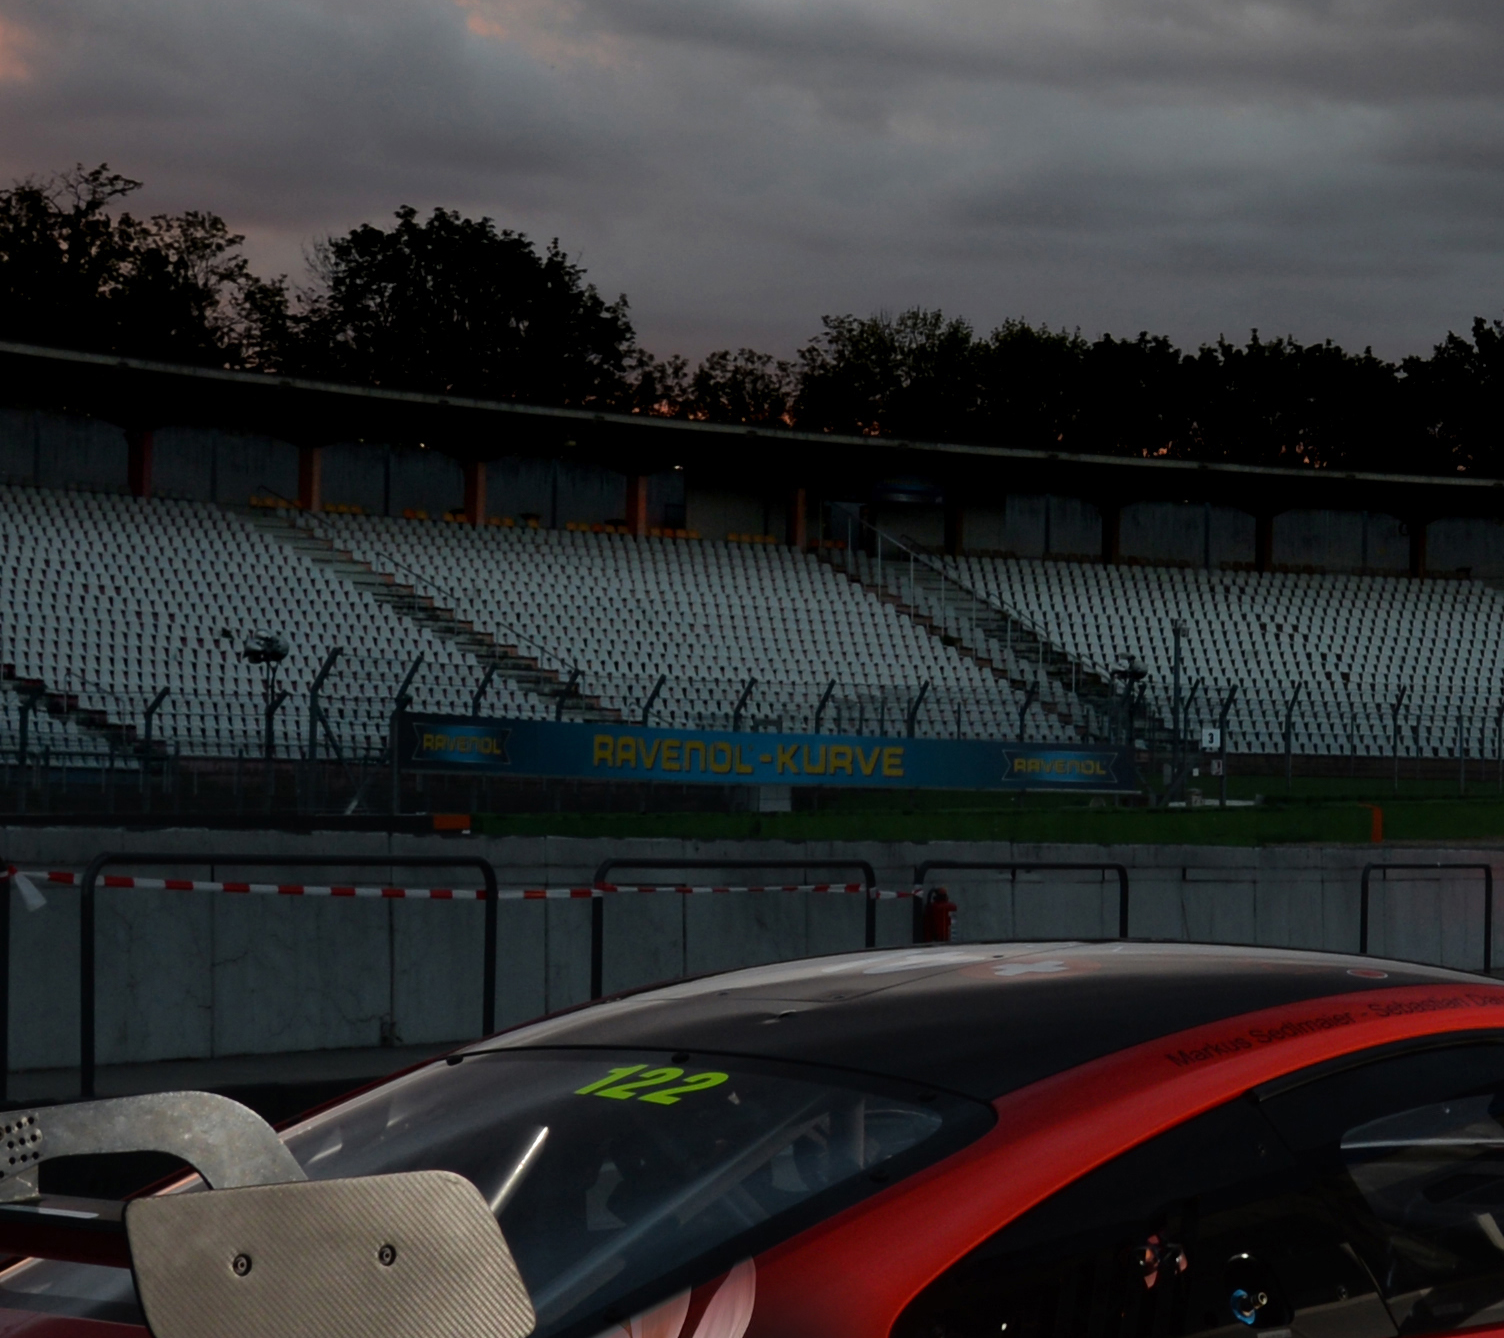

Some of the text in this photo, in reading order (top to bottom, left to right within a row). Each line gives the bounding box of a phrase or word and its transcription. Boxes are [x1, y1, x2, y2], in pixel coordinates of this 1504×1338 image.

[422, 733, 502, 755] RAVENOL
[1013, 758, 1107, 775] RAVENOL
[1165, 1035, 1253, 1067] Markus
[1368, 996, 1466, 1018] Sebastian
[574, 1064, 729, 1105] 122
